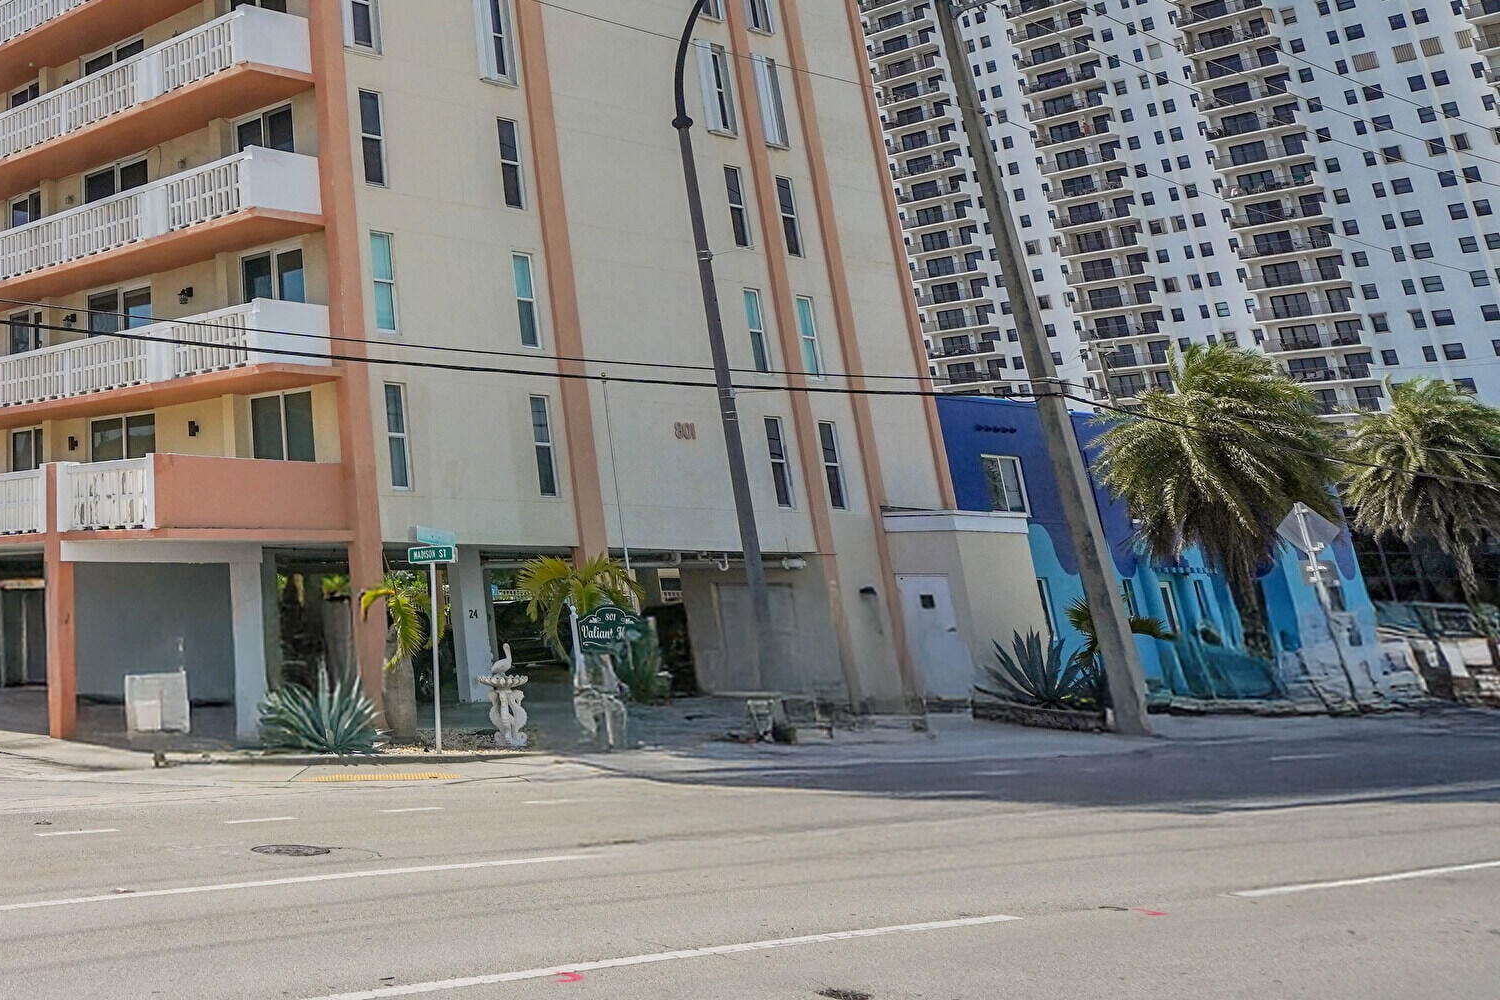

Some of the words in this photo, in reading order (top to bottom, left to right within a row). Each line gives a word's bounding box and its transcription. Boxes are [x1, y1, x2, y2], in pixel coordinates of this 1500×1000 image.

[674, 421, 696, 440] 801
[413, 550, 436, 560] MADISON
[438, 549, 447, 559] ST
[468, 609, 478, 619] 24
[604, 613, 616, 621] 801
[581, 625, 614, 640] Valiant
